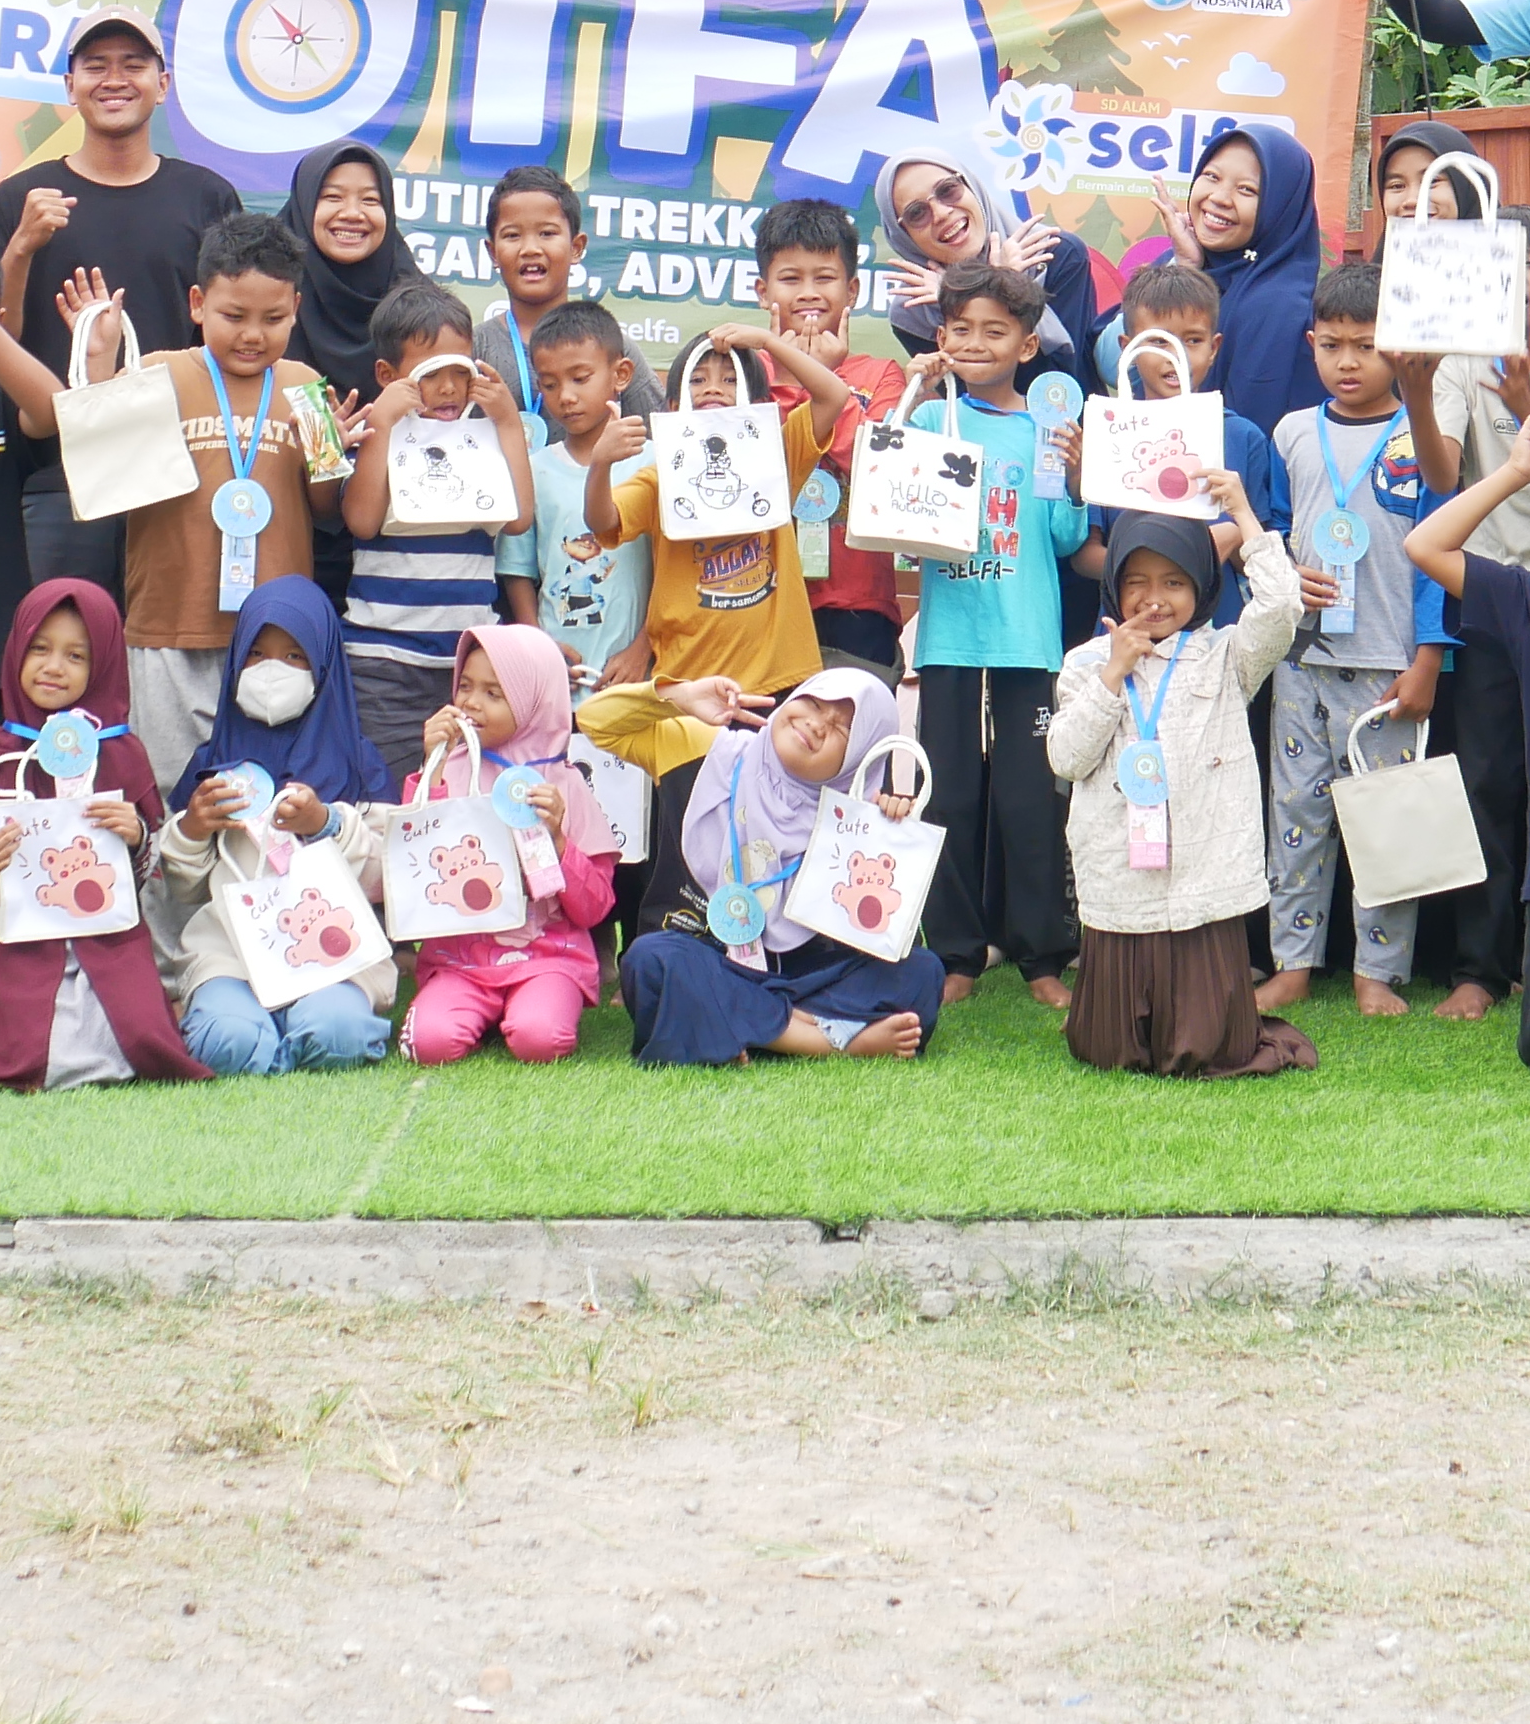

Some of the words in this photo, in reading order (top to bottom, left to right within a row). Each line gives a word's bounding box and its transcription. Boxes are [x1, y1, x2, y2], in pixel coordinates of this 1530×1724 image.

[1100, 98, 1120, 111] SD
[1121, 99, 1161, 115] ALAM
[1086, 113, 1239, 174] self
[1076, 178, 1126, 192] Bermain
[1127, 181, 1149, 194] dan
[1109, 415, 1150, 435] cute
[888, 479, 948, 507] HELLO
[891, 499, 940, 518] Autumn
[403, 817, 440, 843] cute
[836, 817, 870, 836] cute
[251, 886, 281, 920] cute
